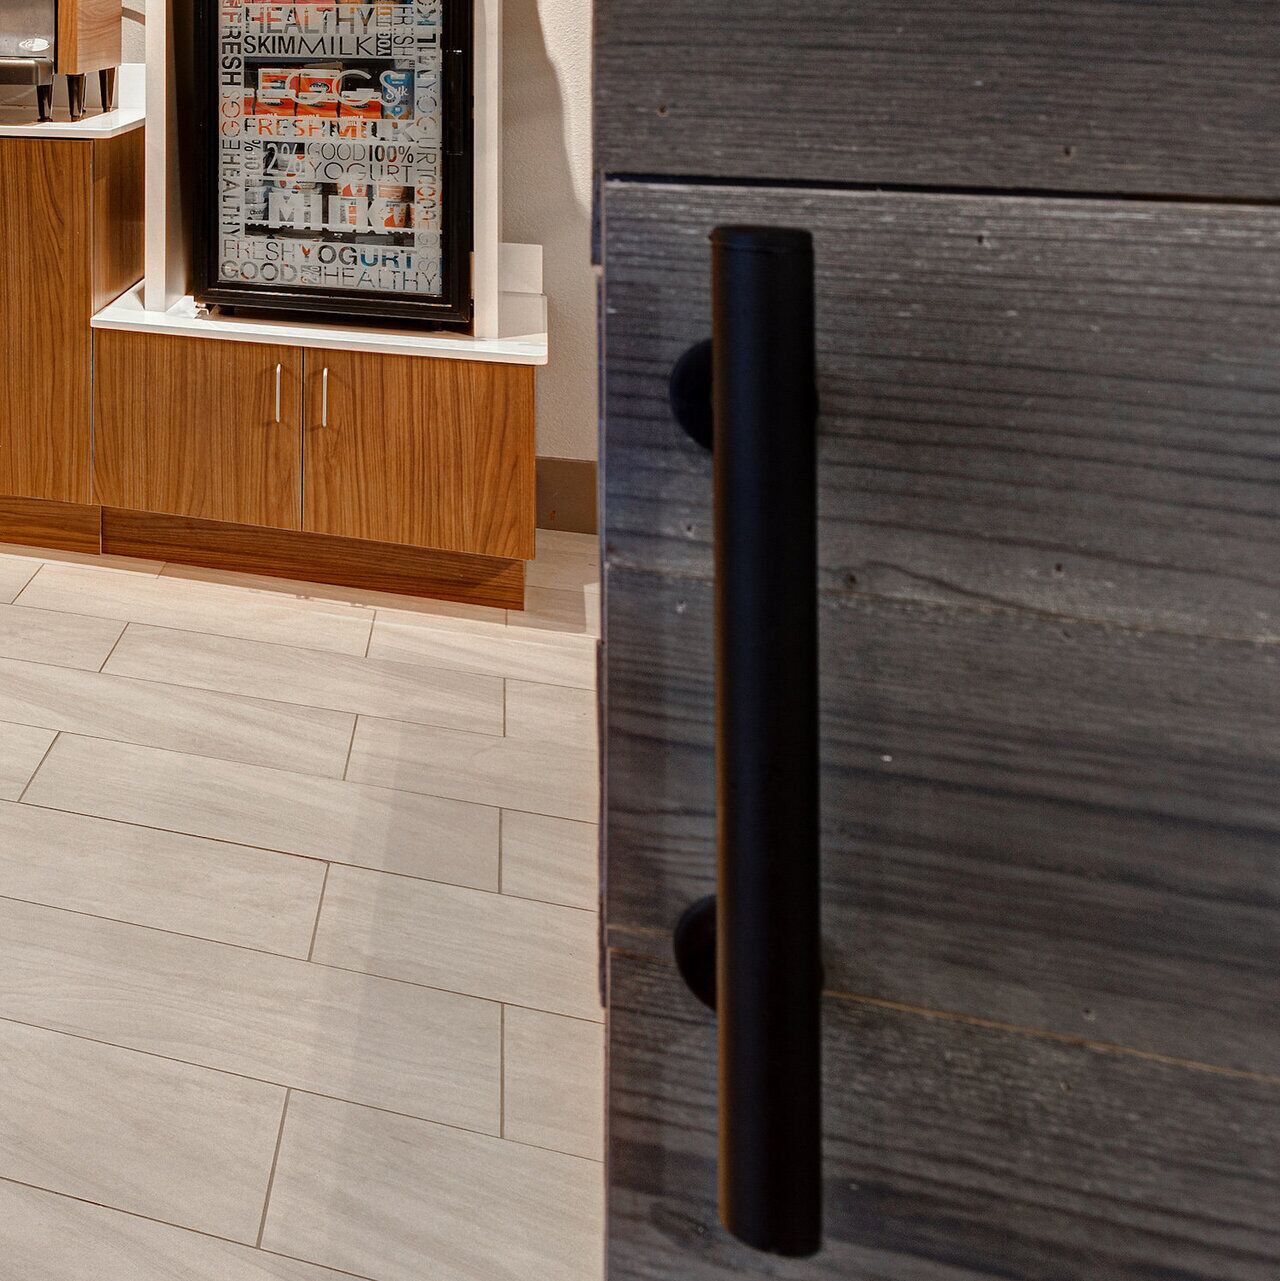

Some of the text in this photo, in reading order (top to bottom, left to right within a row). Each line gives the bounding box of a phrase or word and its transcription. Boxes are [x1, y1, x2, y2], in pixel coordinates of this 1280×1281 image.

[245, 6, 376, 35] HEALTHY
[222, 11, 242, 87] FRESH
[243, 35, 374, 56] SKIM MILK
[244, 117, 326, 138] FRESH
[307, 142, 366, 161] GOOD
[369, 144, 414, 164] 100%
[308, 161, 413, 183] YOGURT
[222, 151, 242, 238] HEALTHY
[223, 239, 417, 269] FRESH YOGURT
[220, 260, 298, 282] GOOD
[323, 265, 438, 292] HEALTHY
